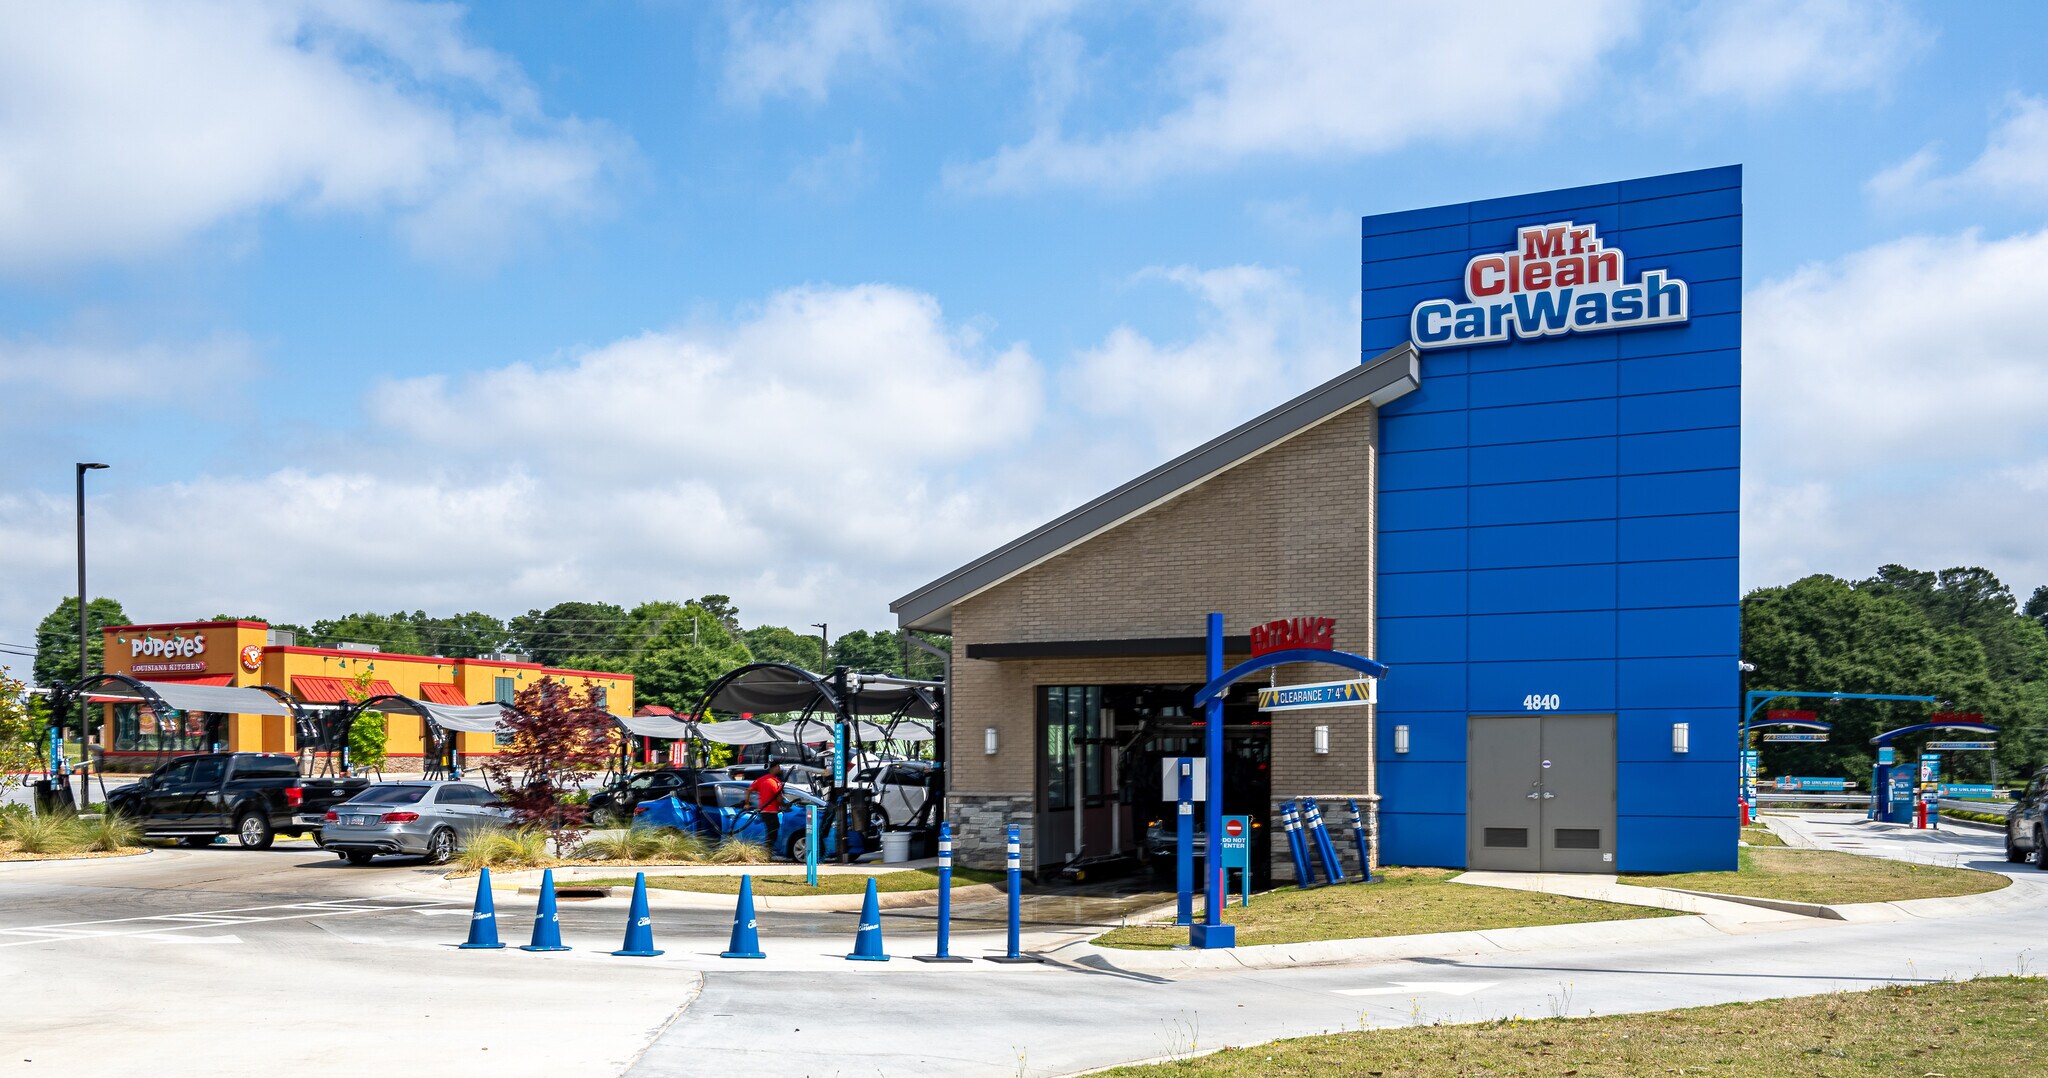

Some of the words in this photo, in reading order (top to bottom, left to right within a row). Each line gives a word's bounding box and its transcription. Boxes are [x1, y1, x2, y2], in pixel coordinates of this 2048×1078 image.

[1522, 226, 1597, 261] Mr.
[1469, 252, 1618, 298] Clean
[1250, 616, 1336, 657] ENTRANCE
[132, 663, 168, 672] LOUISIANA
[168, 662, 201, 671] KITCHEN
[1280, 689, 1322, 704] CLEARANCE
[1523, 693, 1560, 711] 4840
[835, 750, 843, 780] VACUUM
